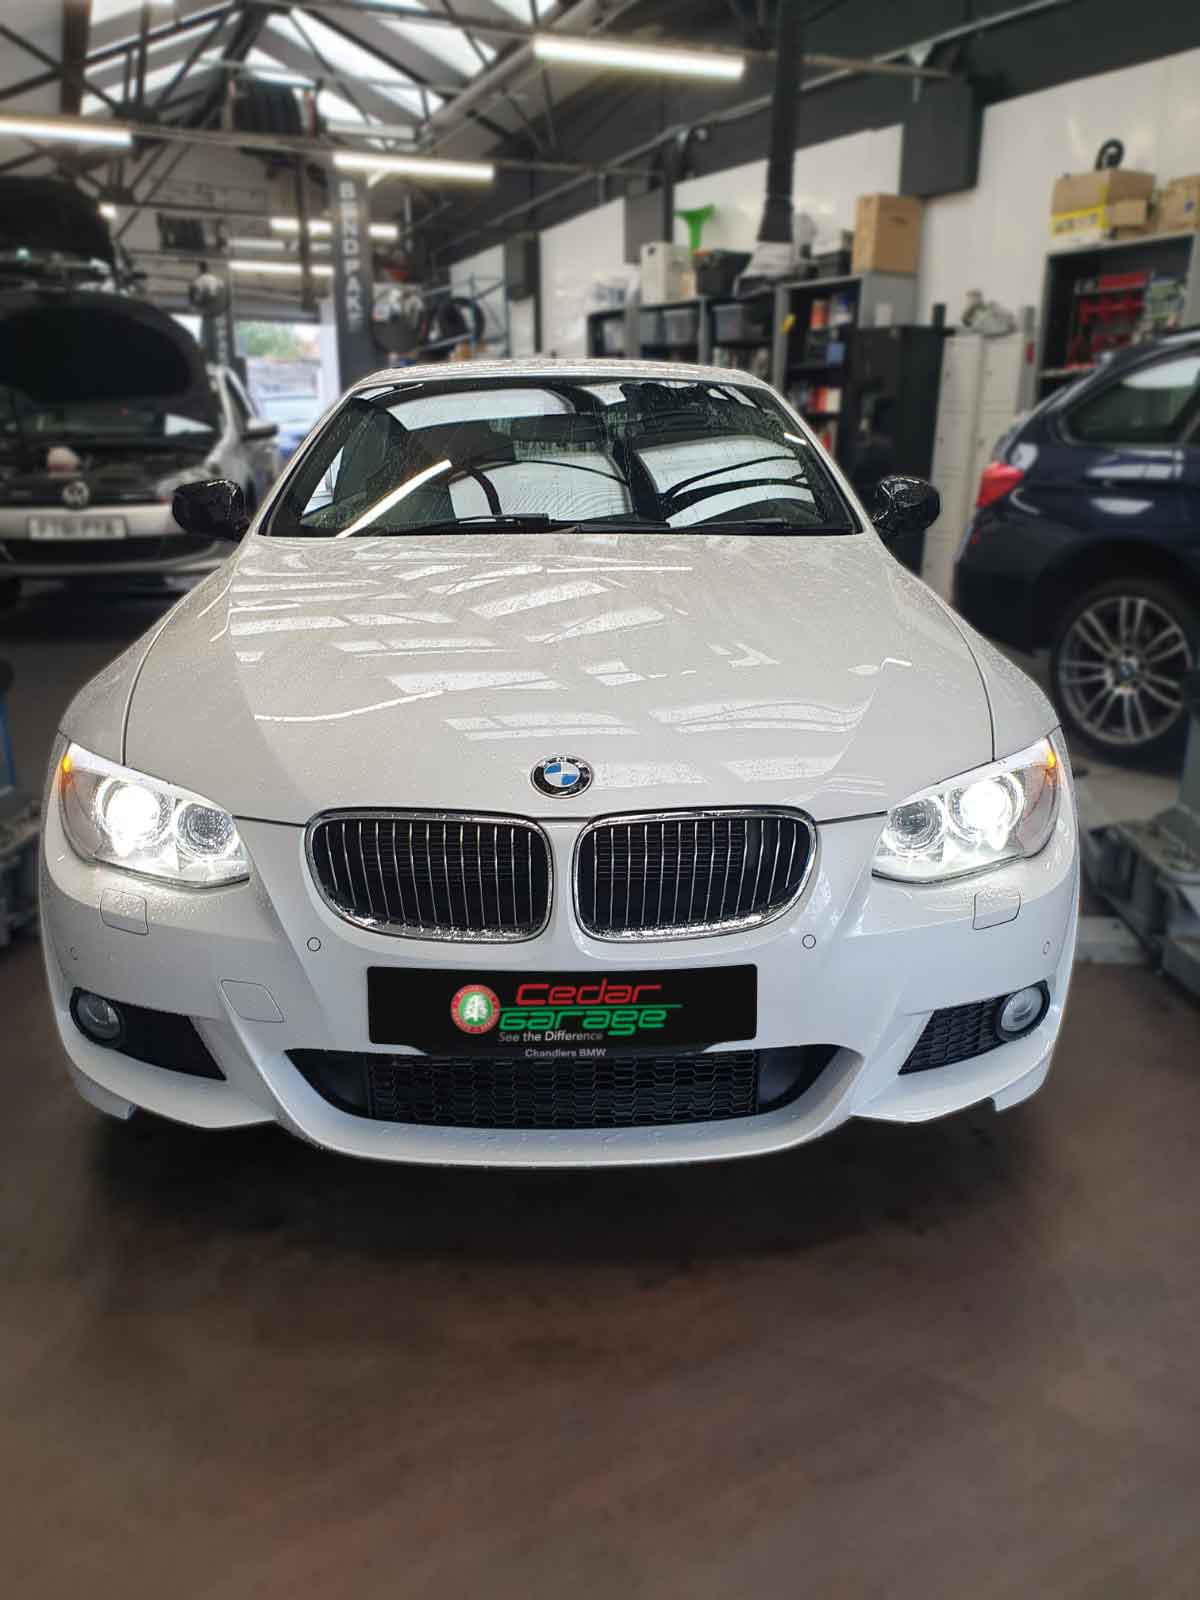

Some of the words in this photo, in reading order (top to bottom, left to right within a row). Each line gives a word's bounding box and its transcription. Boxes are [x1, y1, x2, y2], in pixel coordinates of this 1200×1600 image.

[515, 978, 662, 1006] Cedar
[499, 1030, 520, 1043] See
[523, 1031, 542, 1042] the
[544, 1029, 604, 1042] Difference
[524, 1047, 577, 1058] Chandlers
[578, 1047, 607, 1057] BMW
